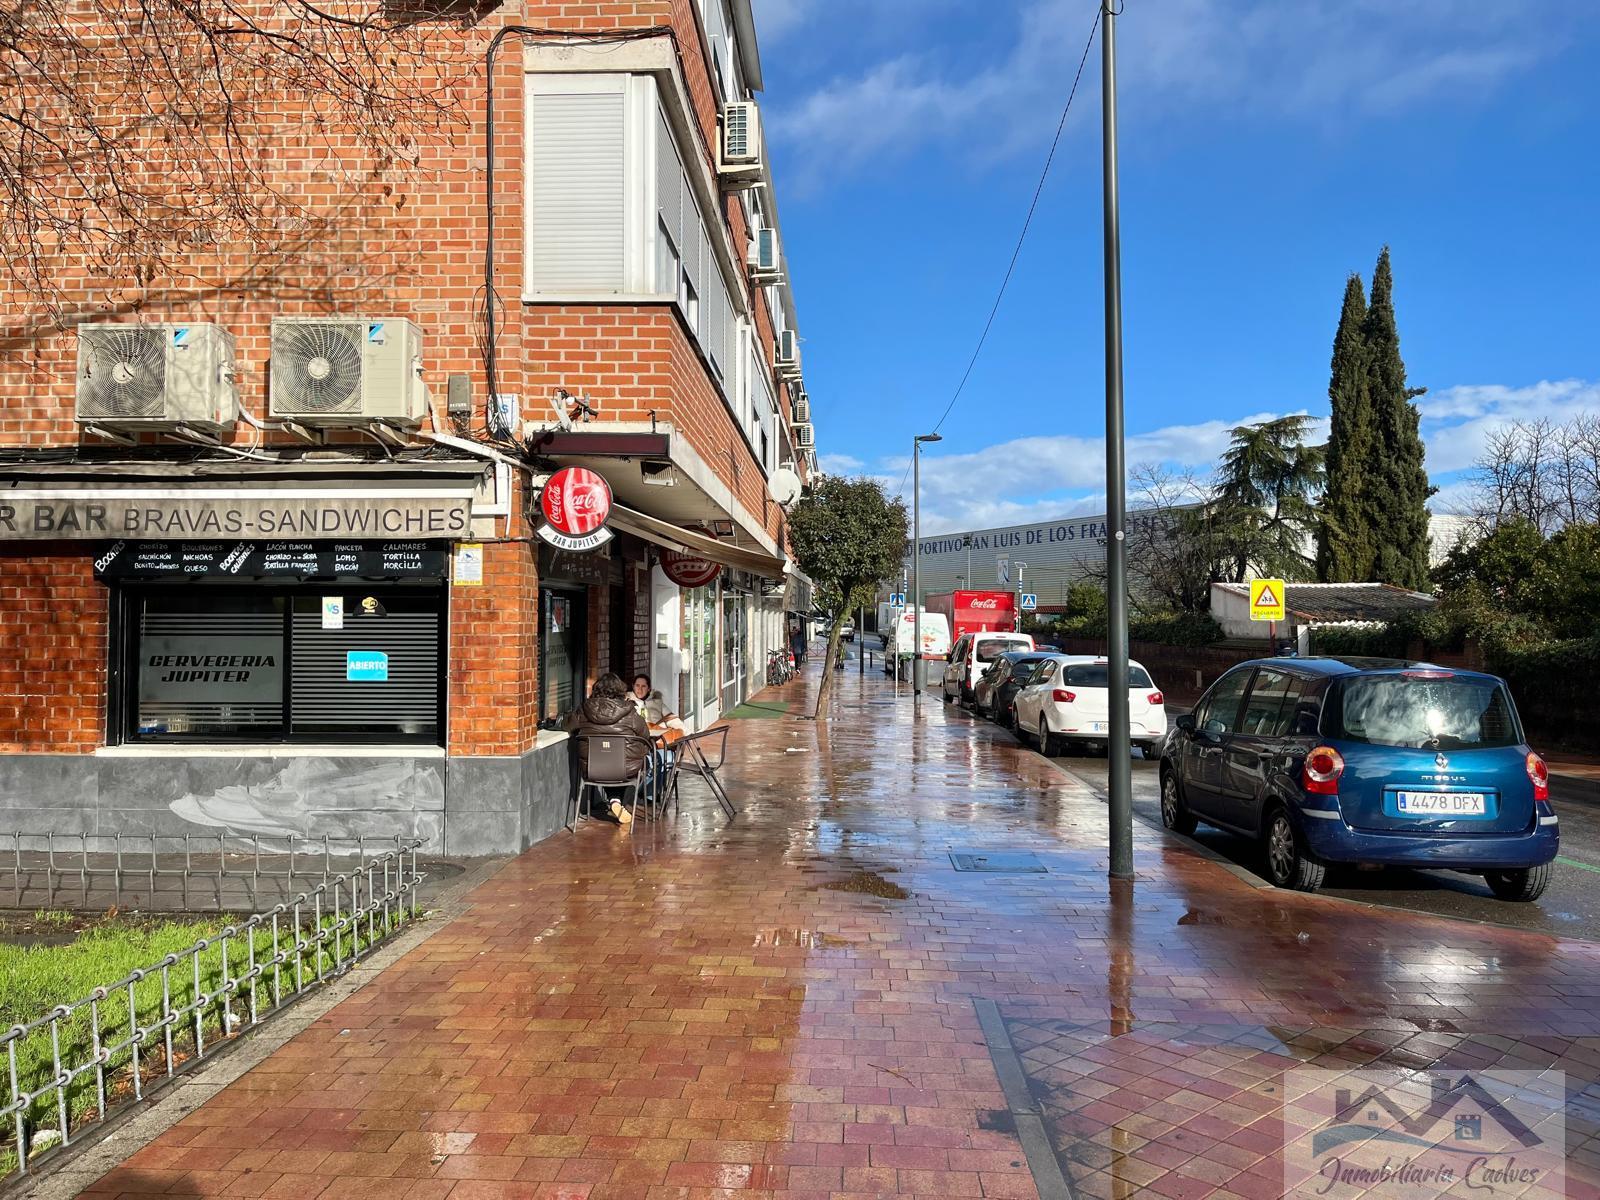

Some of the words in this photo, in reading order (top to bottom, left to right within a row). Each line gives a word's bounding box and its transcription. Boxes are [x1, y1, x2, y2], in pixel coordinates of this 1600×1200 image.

[548, 484, 563, 524] Coca-Cola
[34, 505, 107, 531] BAR
[123, 508, 465, 532] BRAVAS-SANDWICHES
[552, 535, 567, 547] BAR
[567, 535, 600, 548] JUPITER
[906, 539, 962, 556] DPORTIVO
[993, 532, 1020, 547] LUIS
[1026, 530, 1042, 544] DE
[1049, 525, 1075, 542] LOS
[382, 543, 427, 551] CALAMARES
[335, 554, 357, 562] LOMO
[970, 598, 998, 609] Coca-Cola
[149, 655, 276, 667] CERVECERIA
[349, 661, 386, 671] ABIERTO
[161, 670, 251, 682] JUPITER
[1411, 795, 1448, 810] 4478
[1453, 796, 1481, 811] DFX
